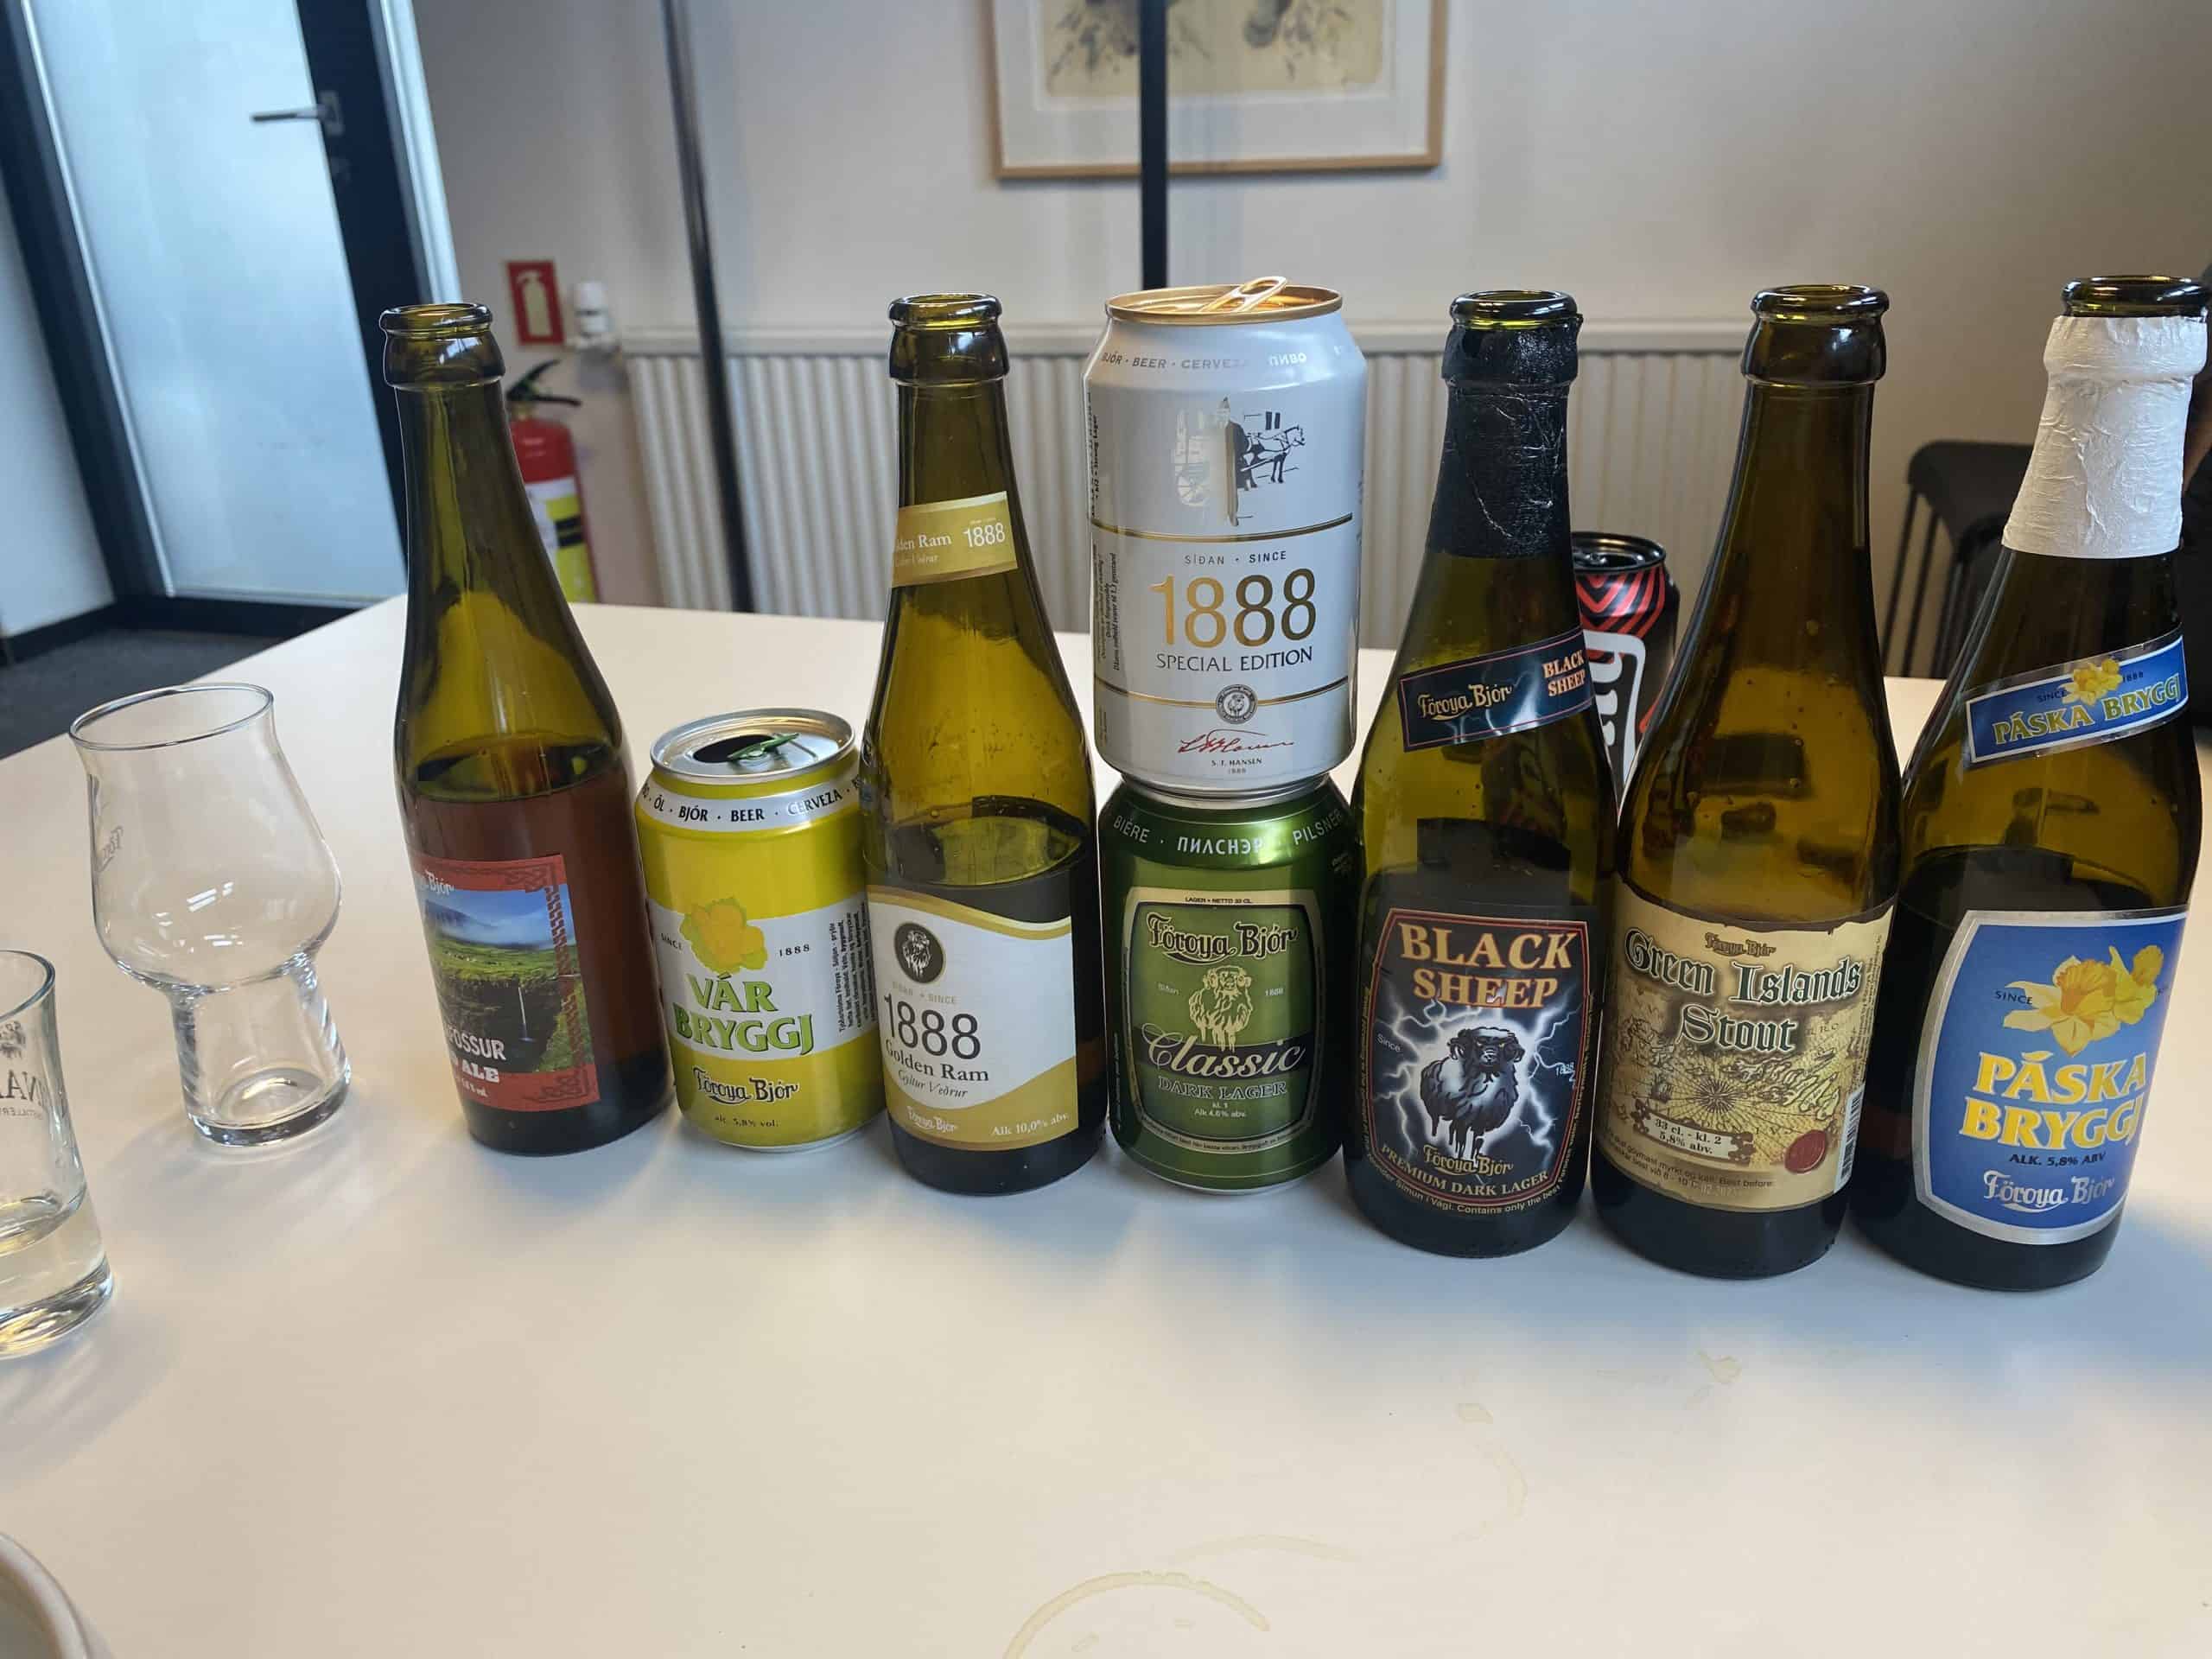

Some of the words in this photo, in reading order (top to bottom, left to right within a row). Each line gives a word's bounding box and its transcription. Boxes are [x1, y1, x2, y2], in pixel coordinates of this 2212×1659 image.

[1132, 356, 1166, 369] BEER
[918, 532, 952, 549] Ram
[963, 522, 1006, 548] 1888
[1249, 550, 1287, 563] SINCE
[1148, 568, 1317, 648] 1888
[1156, 652, 1232, 672] SPECIAL
[1240, 646, 1313, 671] EDITION
[1542, 650, 1585, 678] BLACK
[1548, 669, 1586, 697] SHEEP
[1993, 704, 2095, 746] PÁSKA
[678, 804, 708, 822] BJÓR
[731, 808, 765, 822] BEER
[787, 788, 843, 817] CERVEZA
[1113, 814, 1151, 844] BIÈRE
[779, 943, 810, 958] 1888
[1397, 921, 1578, 969] BLACK
[1624, 927, 1715, 995] Green
[1728, 956, 1864, 1007] Islands
[687, 970, 779, 1014] VÁR
[1412, 967, 1559, 1009] SHEEP
[1994, 988, 2034, 1007] SINCE
[672, 1001, 815, 1056] BRYGGJ
[883, 992, 982, 1060] 1888
[1674, 1002, 1798, 1052] Stout
[1141, 1022, 1306, 1079] Classic
[1376, 1033, 1402, 1052] Since
[885, 1039, 934, 1077] Golden
[940, 1063, 989, 1082] Ram
[1158, 1075, 1213, 1100] DARK
[1219, 1080, 1287, 1101] LAGER
[1972, 1049, 2146, 1105] PÁSKA
[1655, 1118, 1669, 1131] 33
[1714, 1135, 1722, 1145] 2
[1689, 1142, 1713, 1154] abv.
[2009, 1153, 2042, 1166] ALK.
[2046, 1155, 2079, 1167] 5,8%
[1382, 1143, 1447, 1191] PREMIUM
[1452, 1181, 1497, 1197] DARK
[1502, 1170, 1548, 1195] LAGER
[1457, 1205, 1503, 1216] Contains
[1504, 1202, 1525, 1212] only
